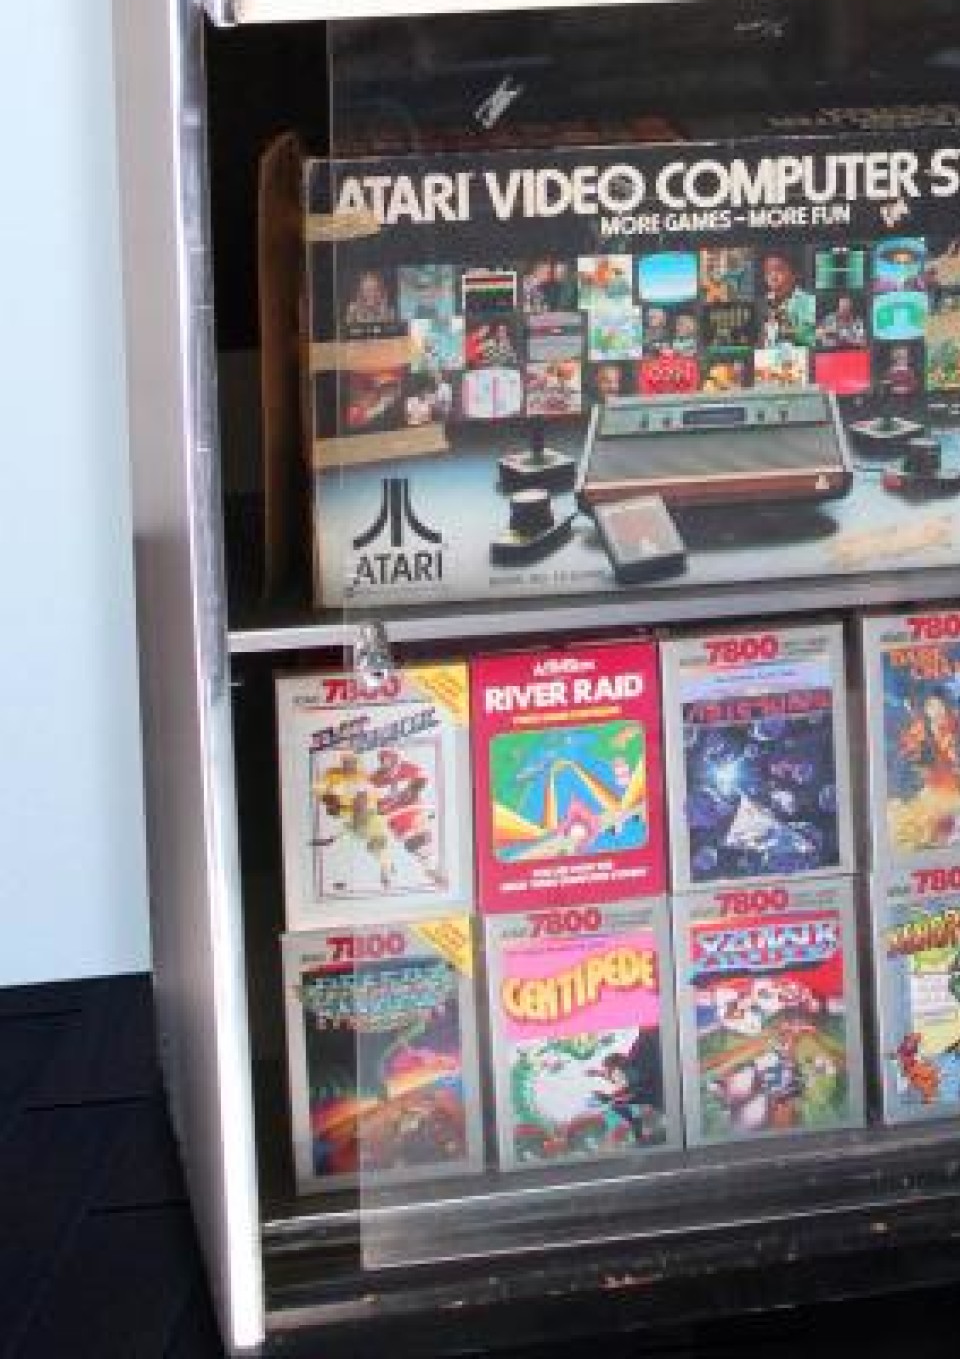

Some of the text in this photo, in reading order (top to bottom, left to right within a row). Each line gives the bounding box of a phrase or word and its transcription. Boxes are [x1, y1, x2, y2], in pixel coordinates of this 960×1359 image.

[333, 172, 473, 225] ATARI
[484, 163, 645, 221] VIDEO
[657, 151, 921, 209] COMPUTER
[601, 214, 660, 236] MORE
[811, 202, 850, 225] FUN
[353, 550, 442, 585] ATARI
[705, 635, 779, 665] 7800
[485, 681, 566, 713] RIVER
[573, 674, 643, 705] RAID
[715, 890, 789, 915] 7800
[528, 908, 603, 937] 7800
[326, 932, 406, 961] 7800
[503, 946, 657, 1022] CENTIPEDE
